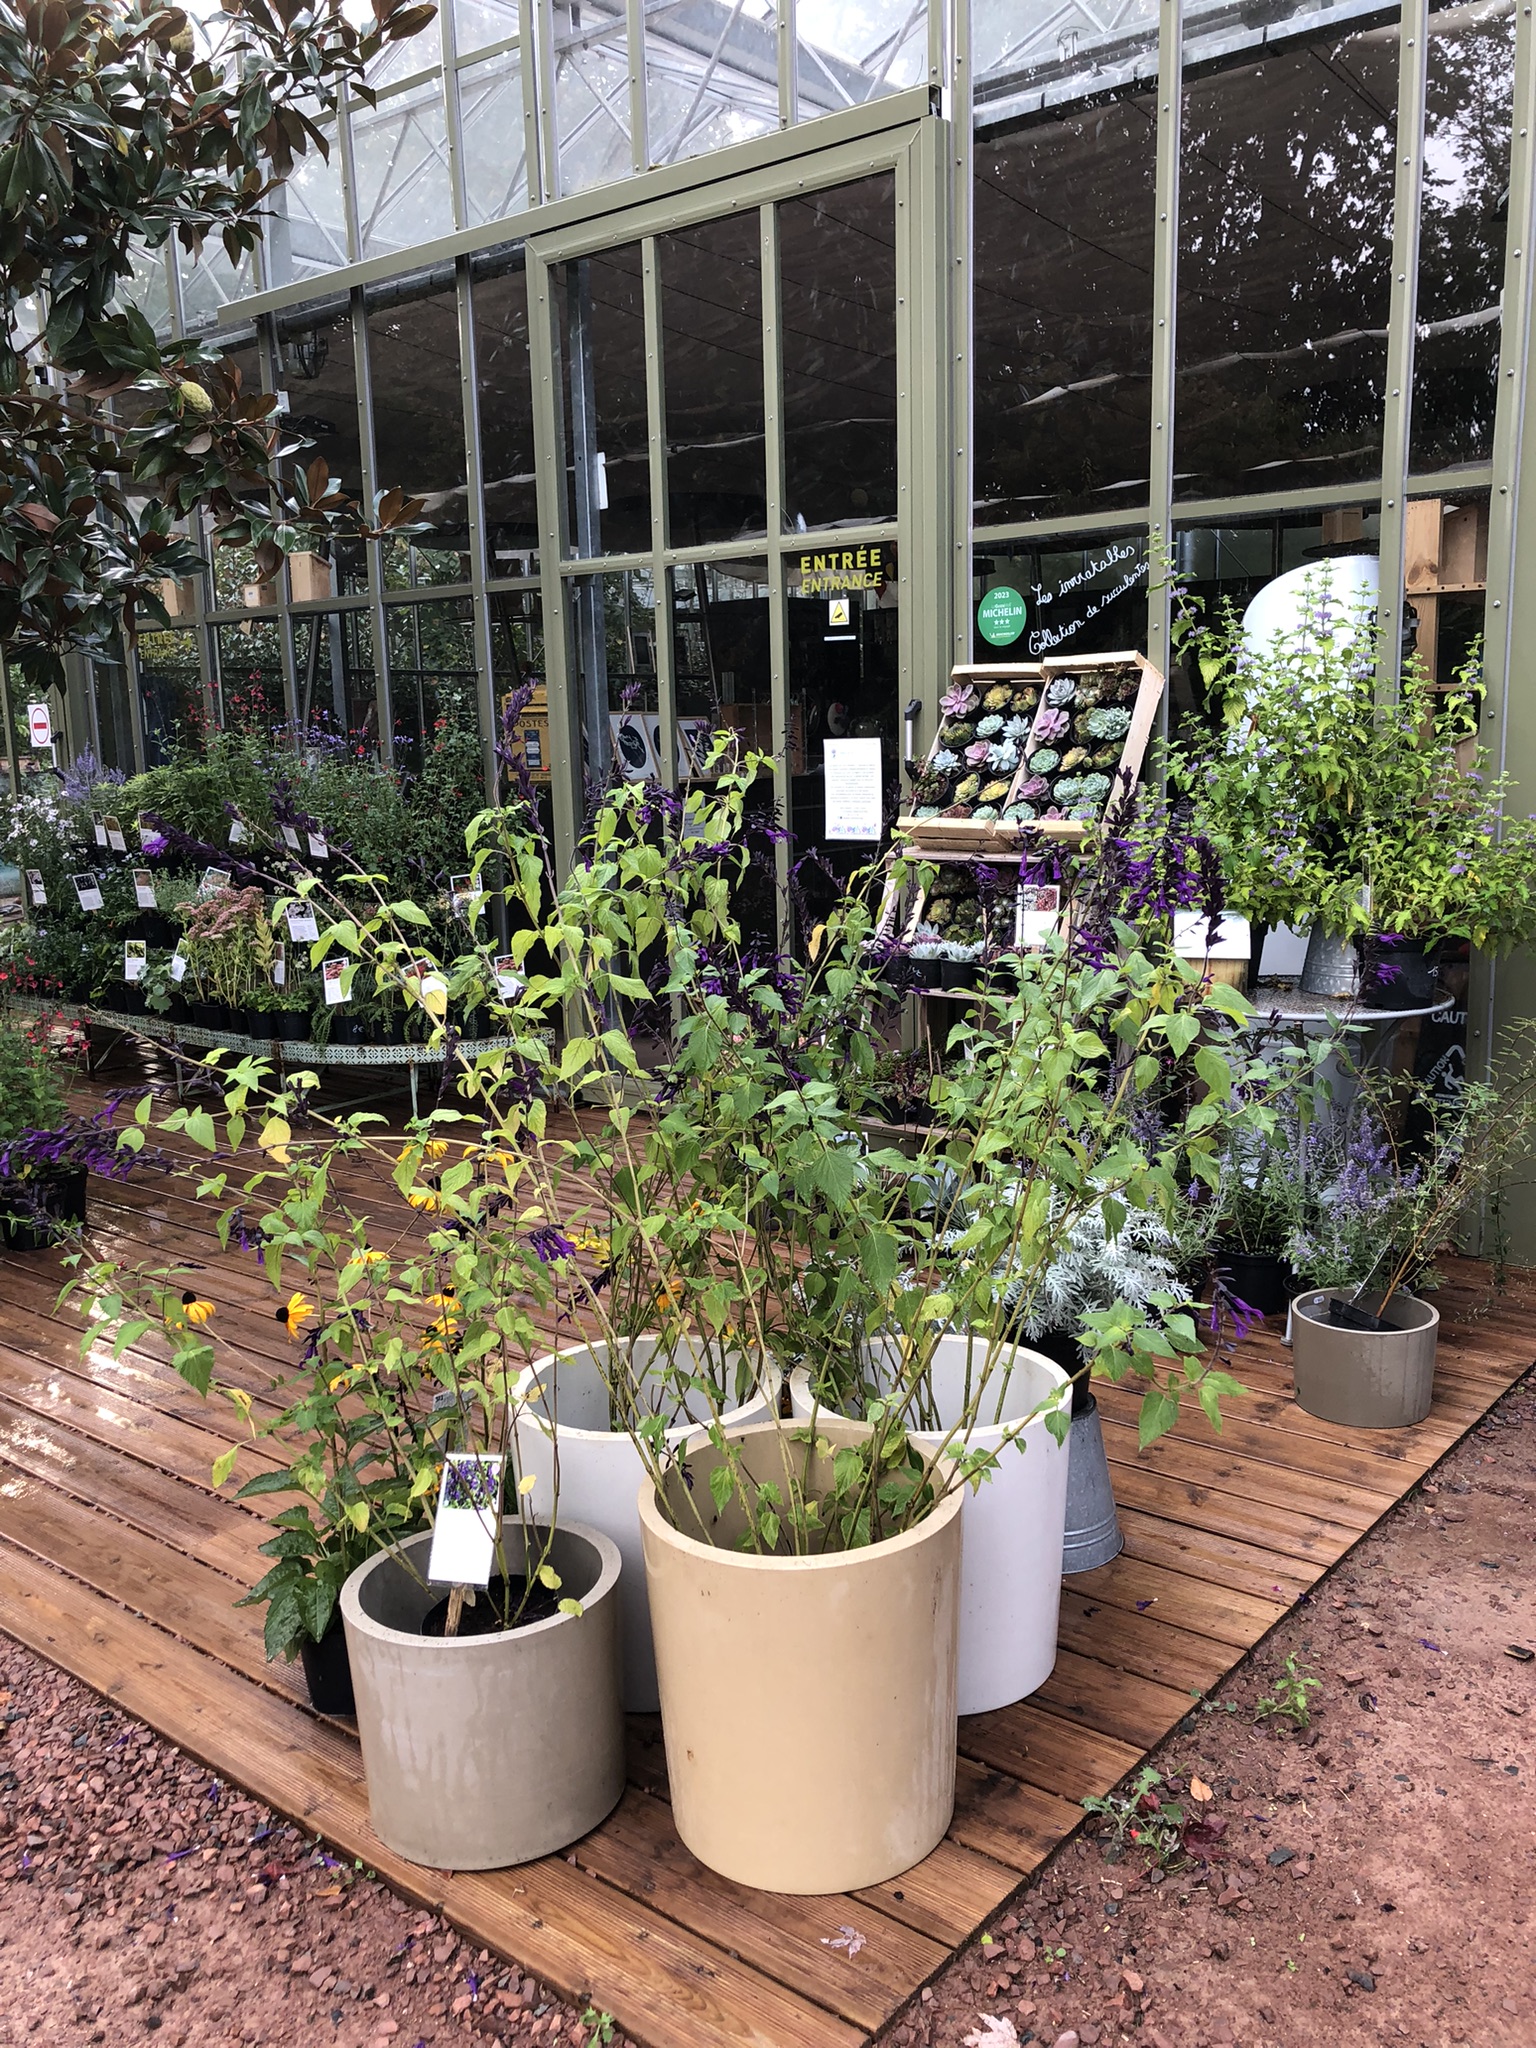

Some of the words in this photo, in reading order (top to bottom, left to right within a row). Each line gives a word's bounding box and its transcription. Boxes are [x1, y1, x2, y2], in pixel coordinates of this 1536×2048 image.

[801, 545, 881, 575] ENTRÉE
[802, 572, 884, 594] ENTRANCE
[994, 591, 1010, 600] 2023
[1031, 583, 1053, 606] Les
[983, 606, 1022, 618] MICHELIN
[1029, 620, 1086, 655] Collection
[1086, 605, 1101, 618] de
[1101, 561, 1150, 607] succulentes
